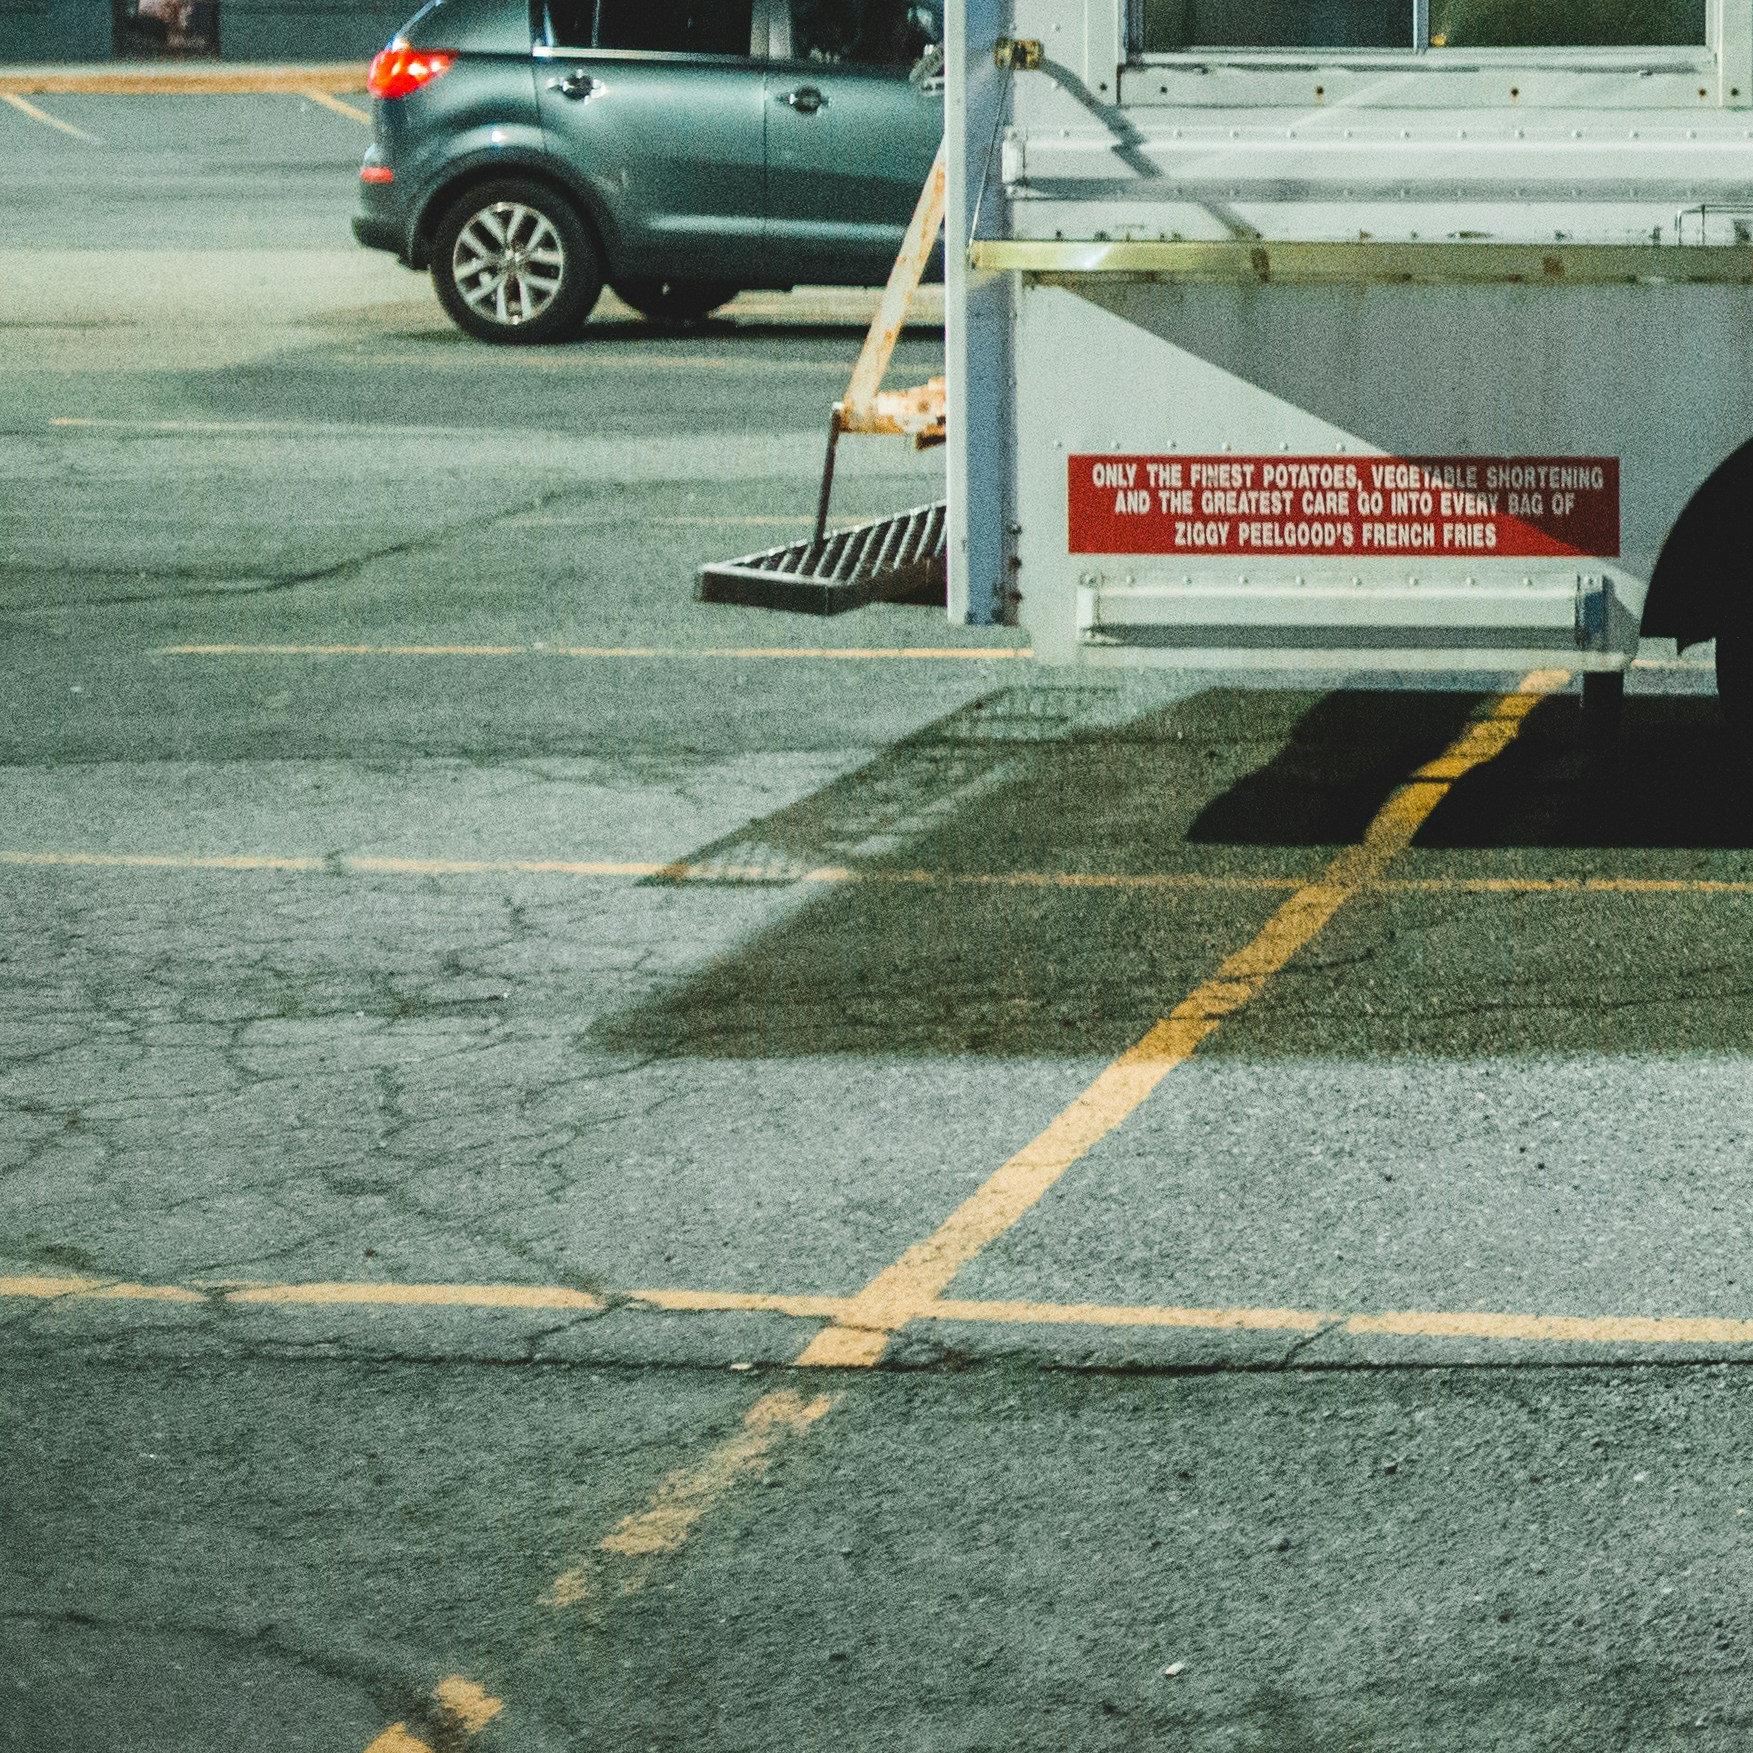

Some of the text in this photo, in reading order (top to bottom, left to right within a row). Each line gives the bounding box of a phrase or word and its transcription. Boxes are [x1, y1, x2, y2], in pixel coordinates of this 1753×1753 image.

[1092, 463, 1605, 494] ONLY THE FINEST POTATOES, VEGETABLE SHORTENING
[1114, 490, 1576, 517] AND THE GREATEST CARE GO INTO EVERY BAG OF
[1173, 521, 1498, 550] ZIGGY PEELGOOD'S FRENCH FRIES
